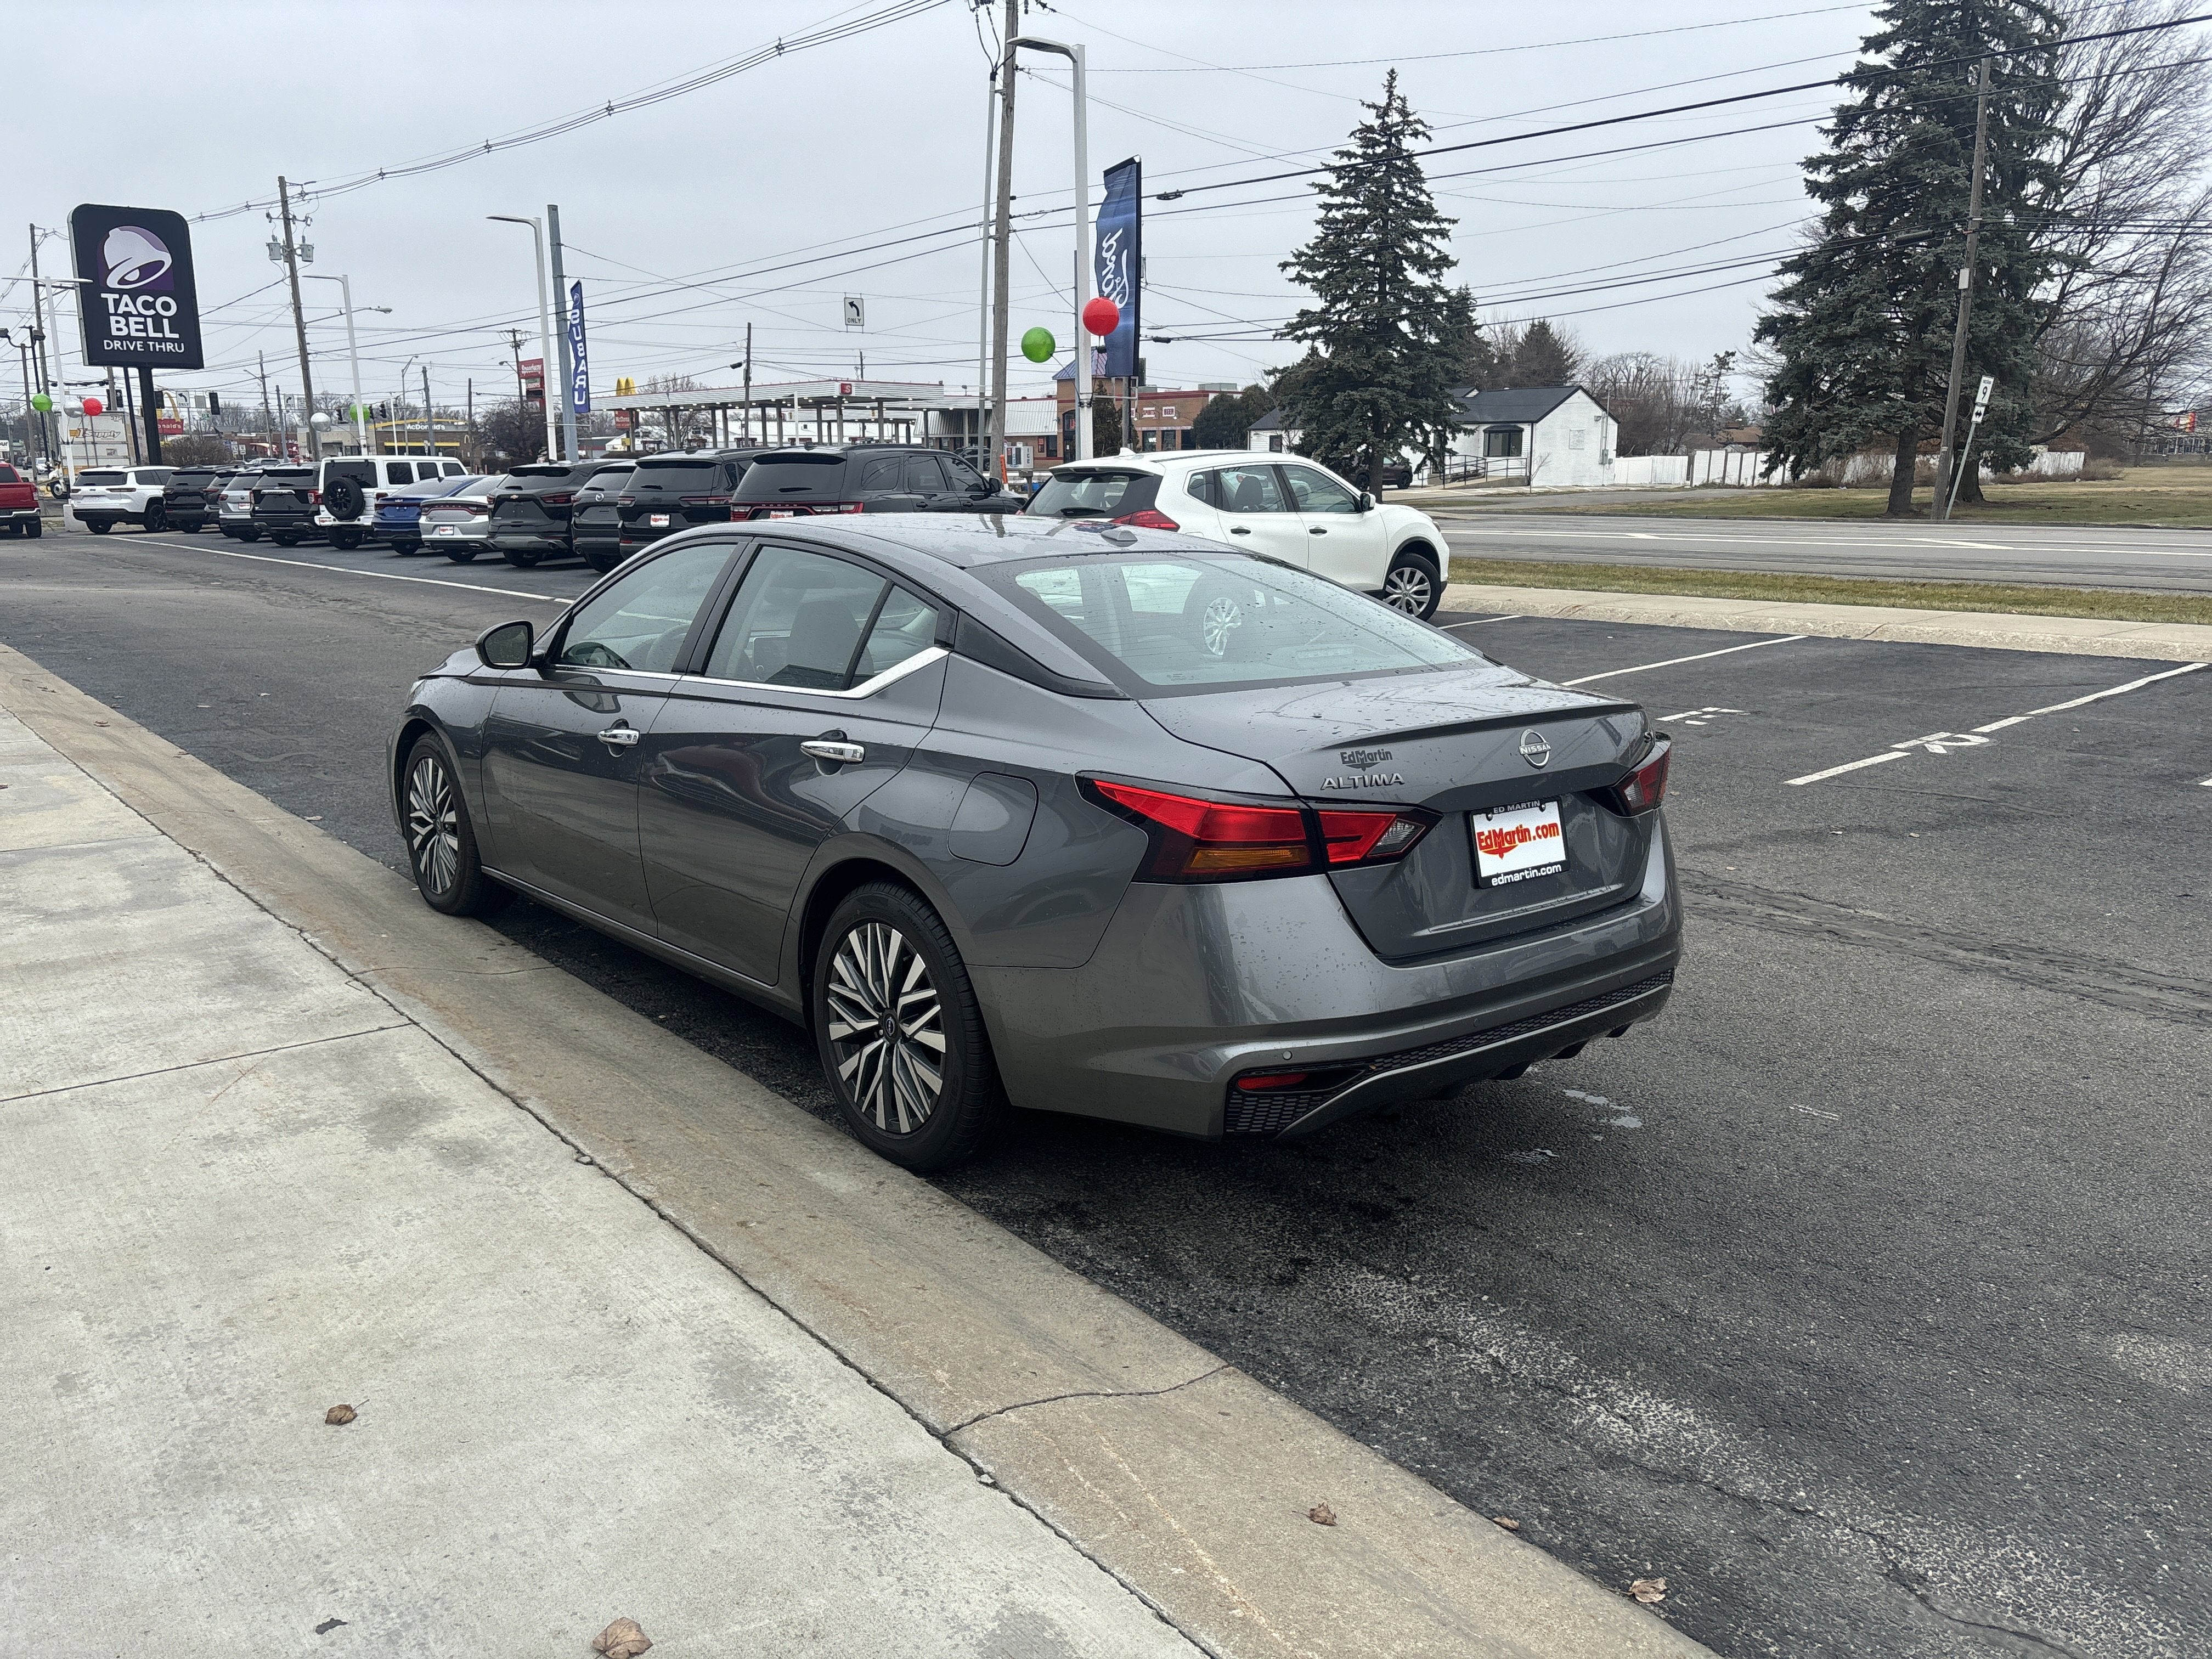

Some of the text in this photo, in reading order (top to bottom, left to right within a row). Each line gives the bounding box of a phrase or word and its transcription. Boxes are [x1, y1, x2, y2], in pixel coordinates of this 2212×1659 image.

[100, 293, 177, 317] TACO
[110, 316, 179, 338] BELL
[104, 340, 184, 353] DRIVE THRU
[1982, 386, 1988, 401] 9
[1340, 748, 1392, 765] EdMartin
[1520, 743, 1551, 754] NISSAN
[1320, 773, 1406, 790] ALTIMA
[1507, 799, 1541, 811] MARTIN
[1476, 822, 1560, 851] EdMartin.com
[1491, 864, 1562, 886] edmartin.com
